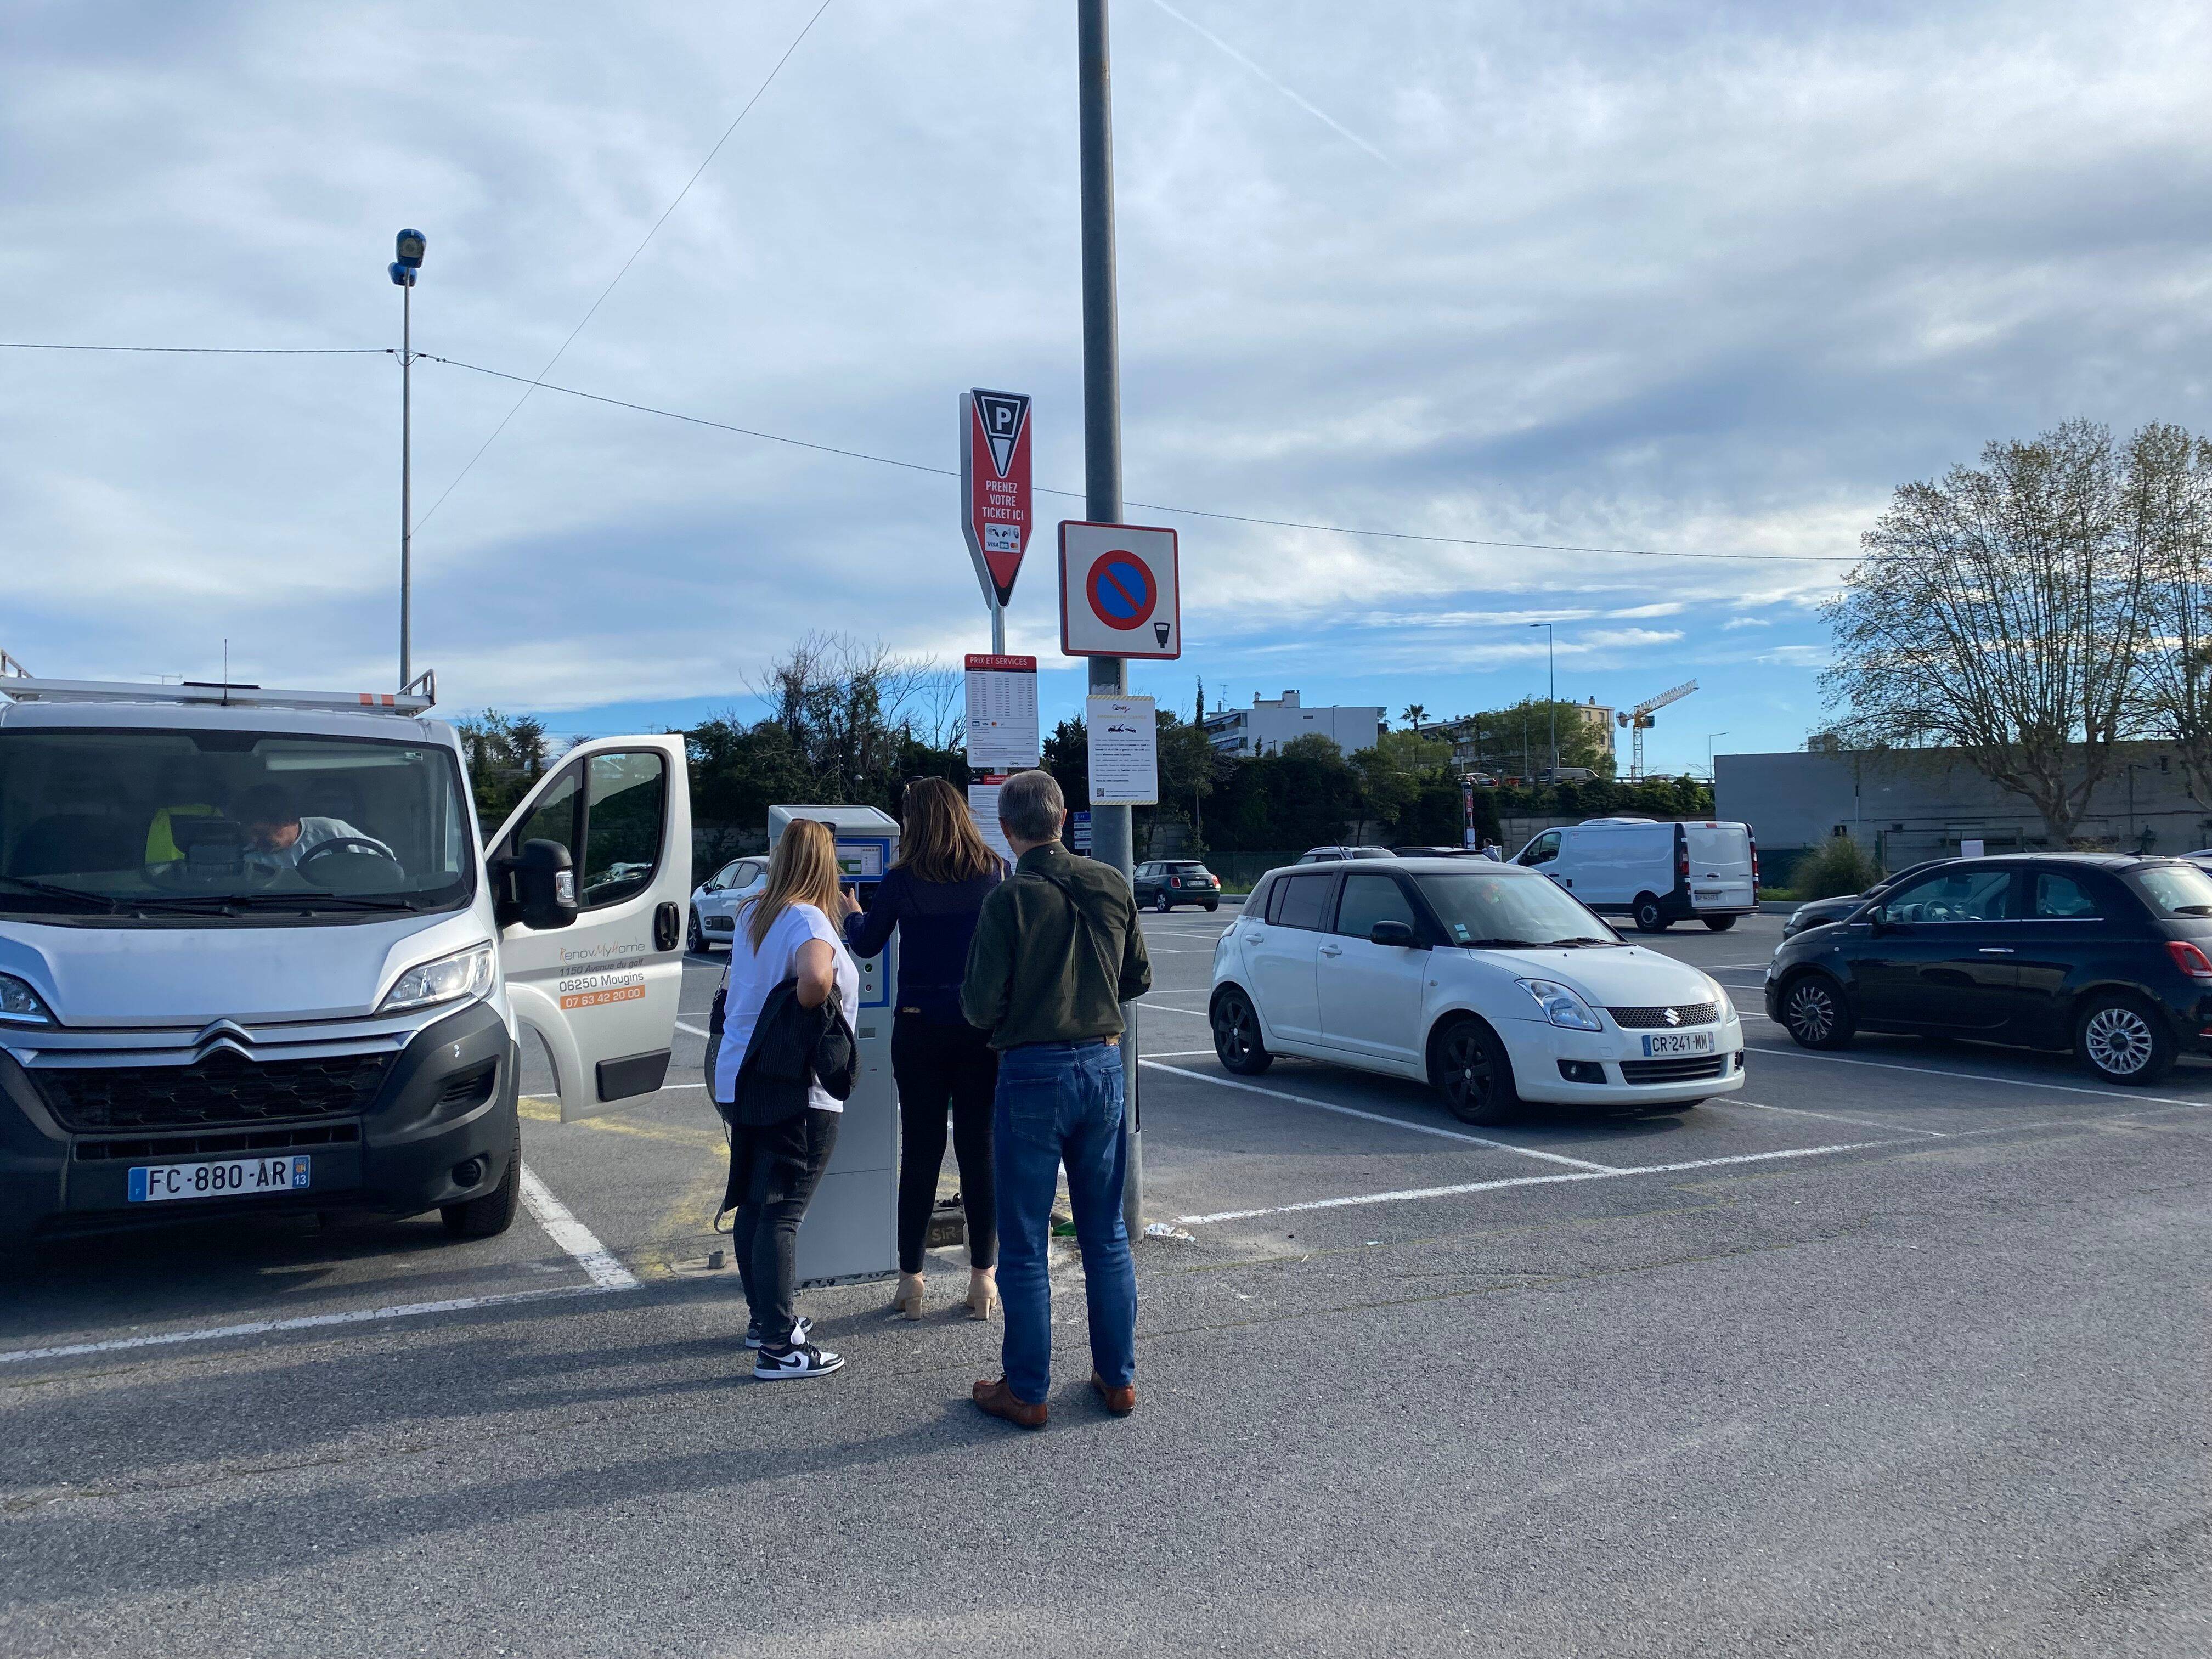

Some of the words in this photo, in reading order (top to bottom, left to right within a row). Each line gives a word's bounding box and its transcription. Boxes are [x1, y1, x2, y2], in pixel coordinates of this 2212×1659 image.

[996, 407, 1011, 431] P
[986, 480, 1018, 493] PRENEZ
[989, 494, 1016, 506] VOTRE
[982, 506, 1011, 520] TICKET
[1013, 509, 1024, 520] ICI
[560, 966, 583, 976] 1150
[585, 963, 614, 973] Avenue
[617, 961, 627, 969] du
[628, 958, 644, 969] golf
[559, 977, 597, 992] 06250
[600, 972, 644, 986] Mougins
[566, 998, 578, 1007] 07
[582, 995, 594, 1005] 63
[597, 993, 610, 1002] 42
[613, 991, 625, 1000] 20
[628, 989, 640, 997] 00
[294, 1174, 307, 1185] 13
